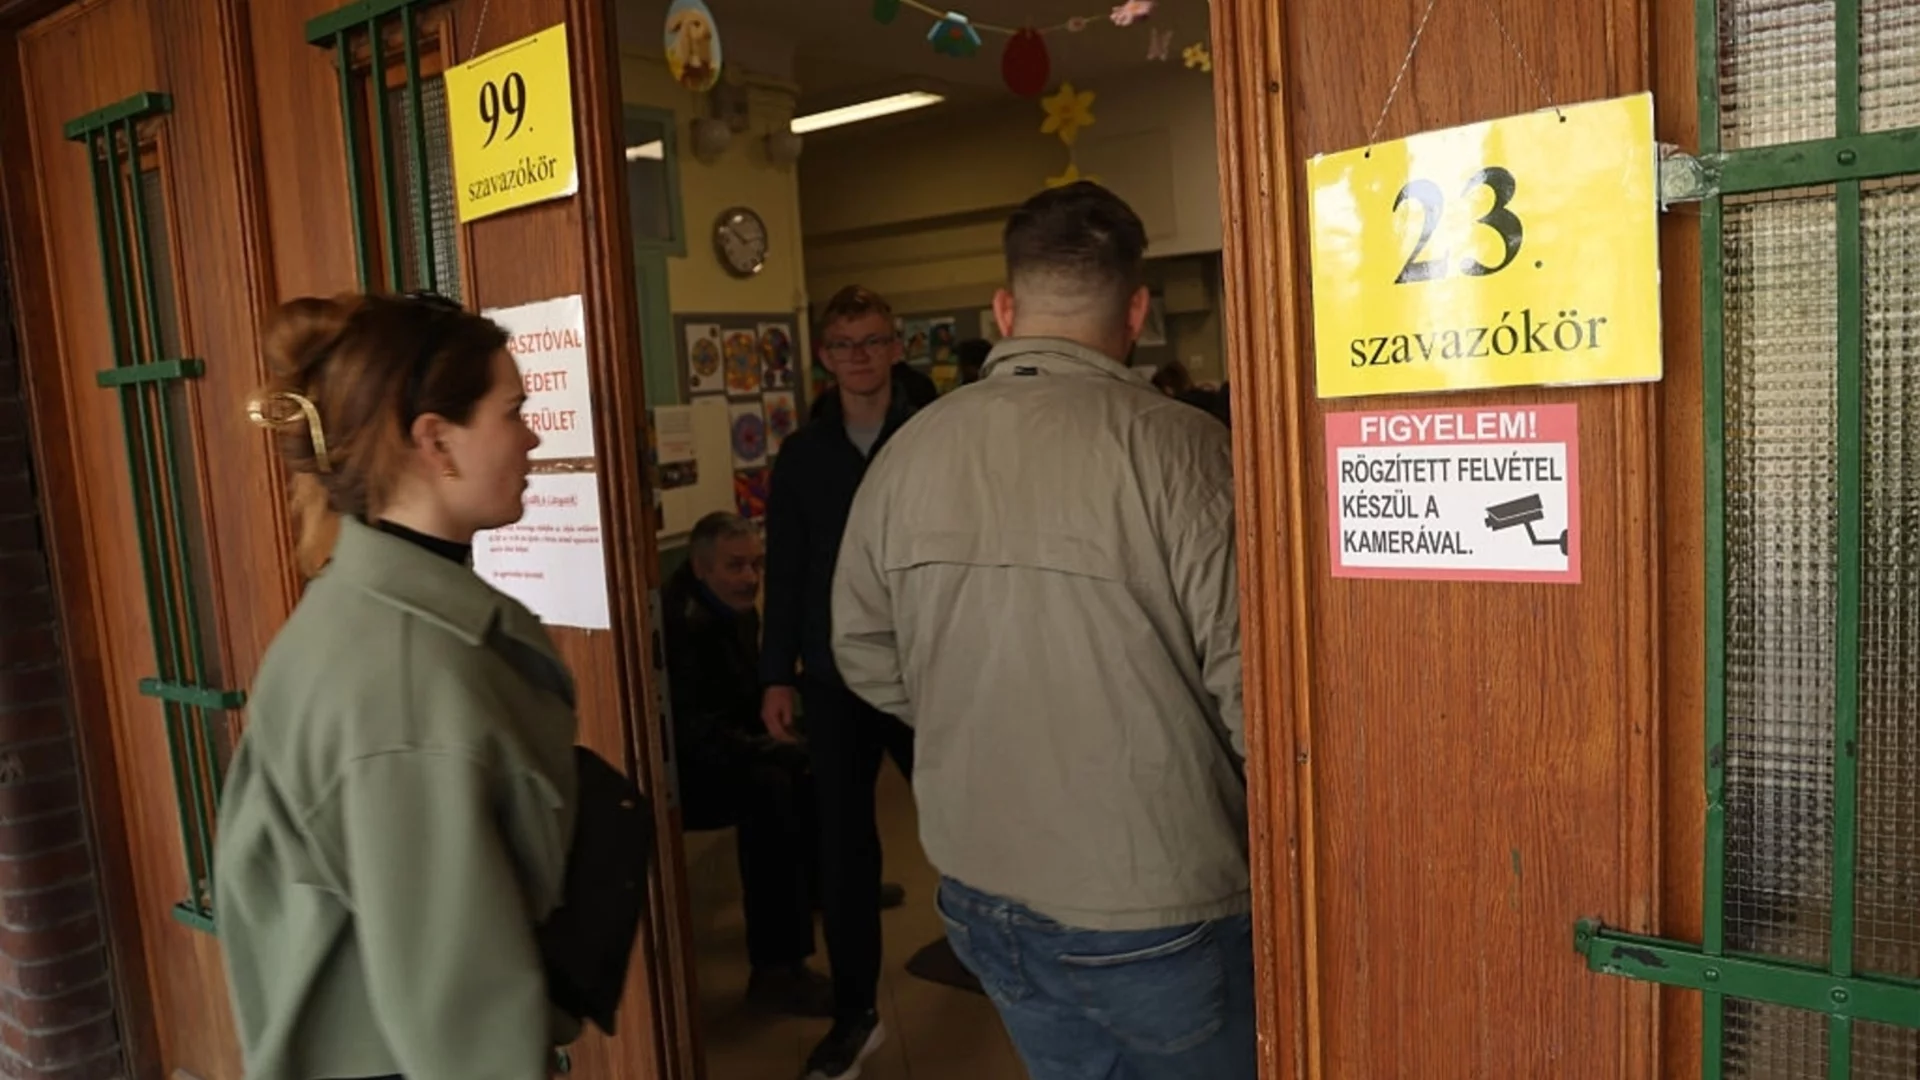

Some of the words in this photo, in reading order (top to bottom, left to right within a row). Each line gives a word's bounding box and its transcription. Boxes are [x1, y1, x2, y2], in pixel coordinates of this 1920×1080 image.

[479, 72, 533, 150] 99.
[467, 154, 557, 202] szavazókör
[1392, 166, 1543, 285] 23.
[508, 325, 582, 354] ASZTÓVAL
[1350, 308, 1607, 368] szavazókör
[522, 368, 567, 393] ÉDETT
[521, 407, 575, 432] ERÜLET
[1360, 411, 1537, 443] FIGYELEM!
[1341, 454, 1451, 483] RÖGZÍTETT
[1458, 451, 1562, 482] FELVÉTEL
[1343, 489, 1418, 519] KÉSZÜL
[1425, 495, 1440, 519] A
[1344, 526, 1473, 555] KAMERÁVAL.
